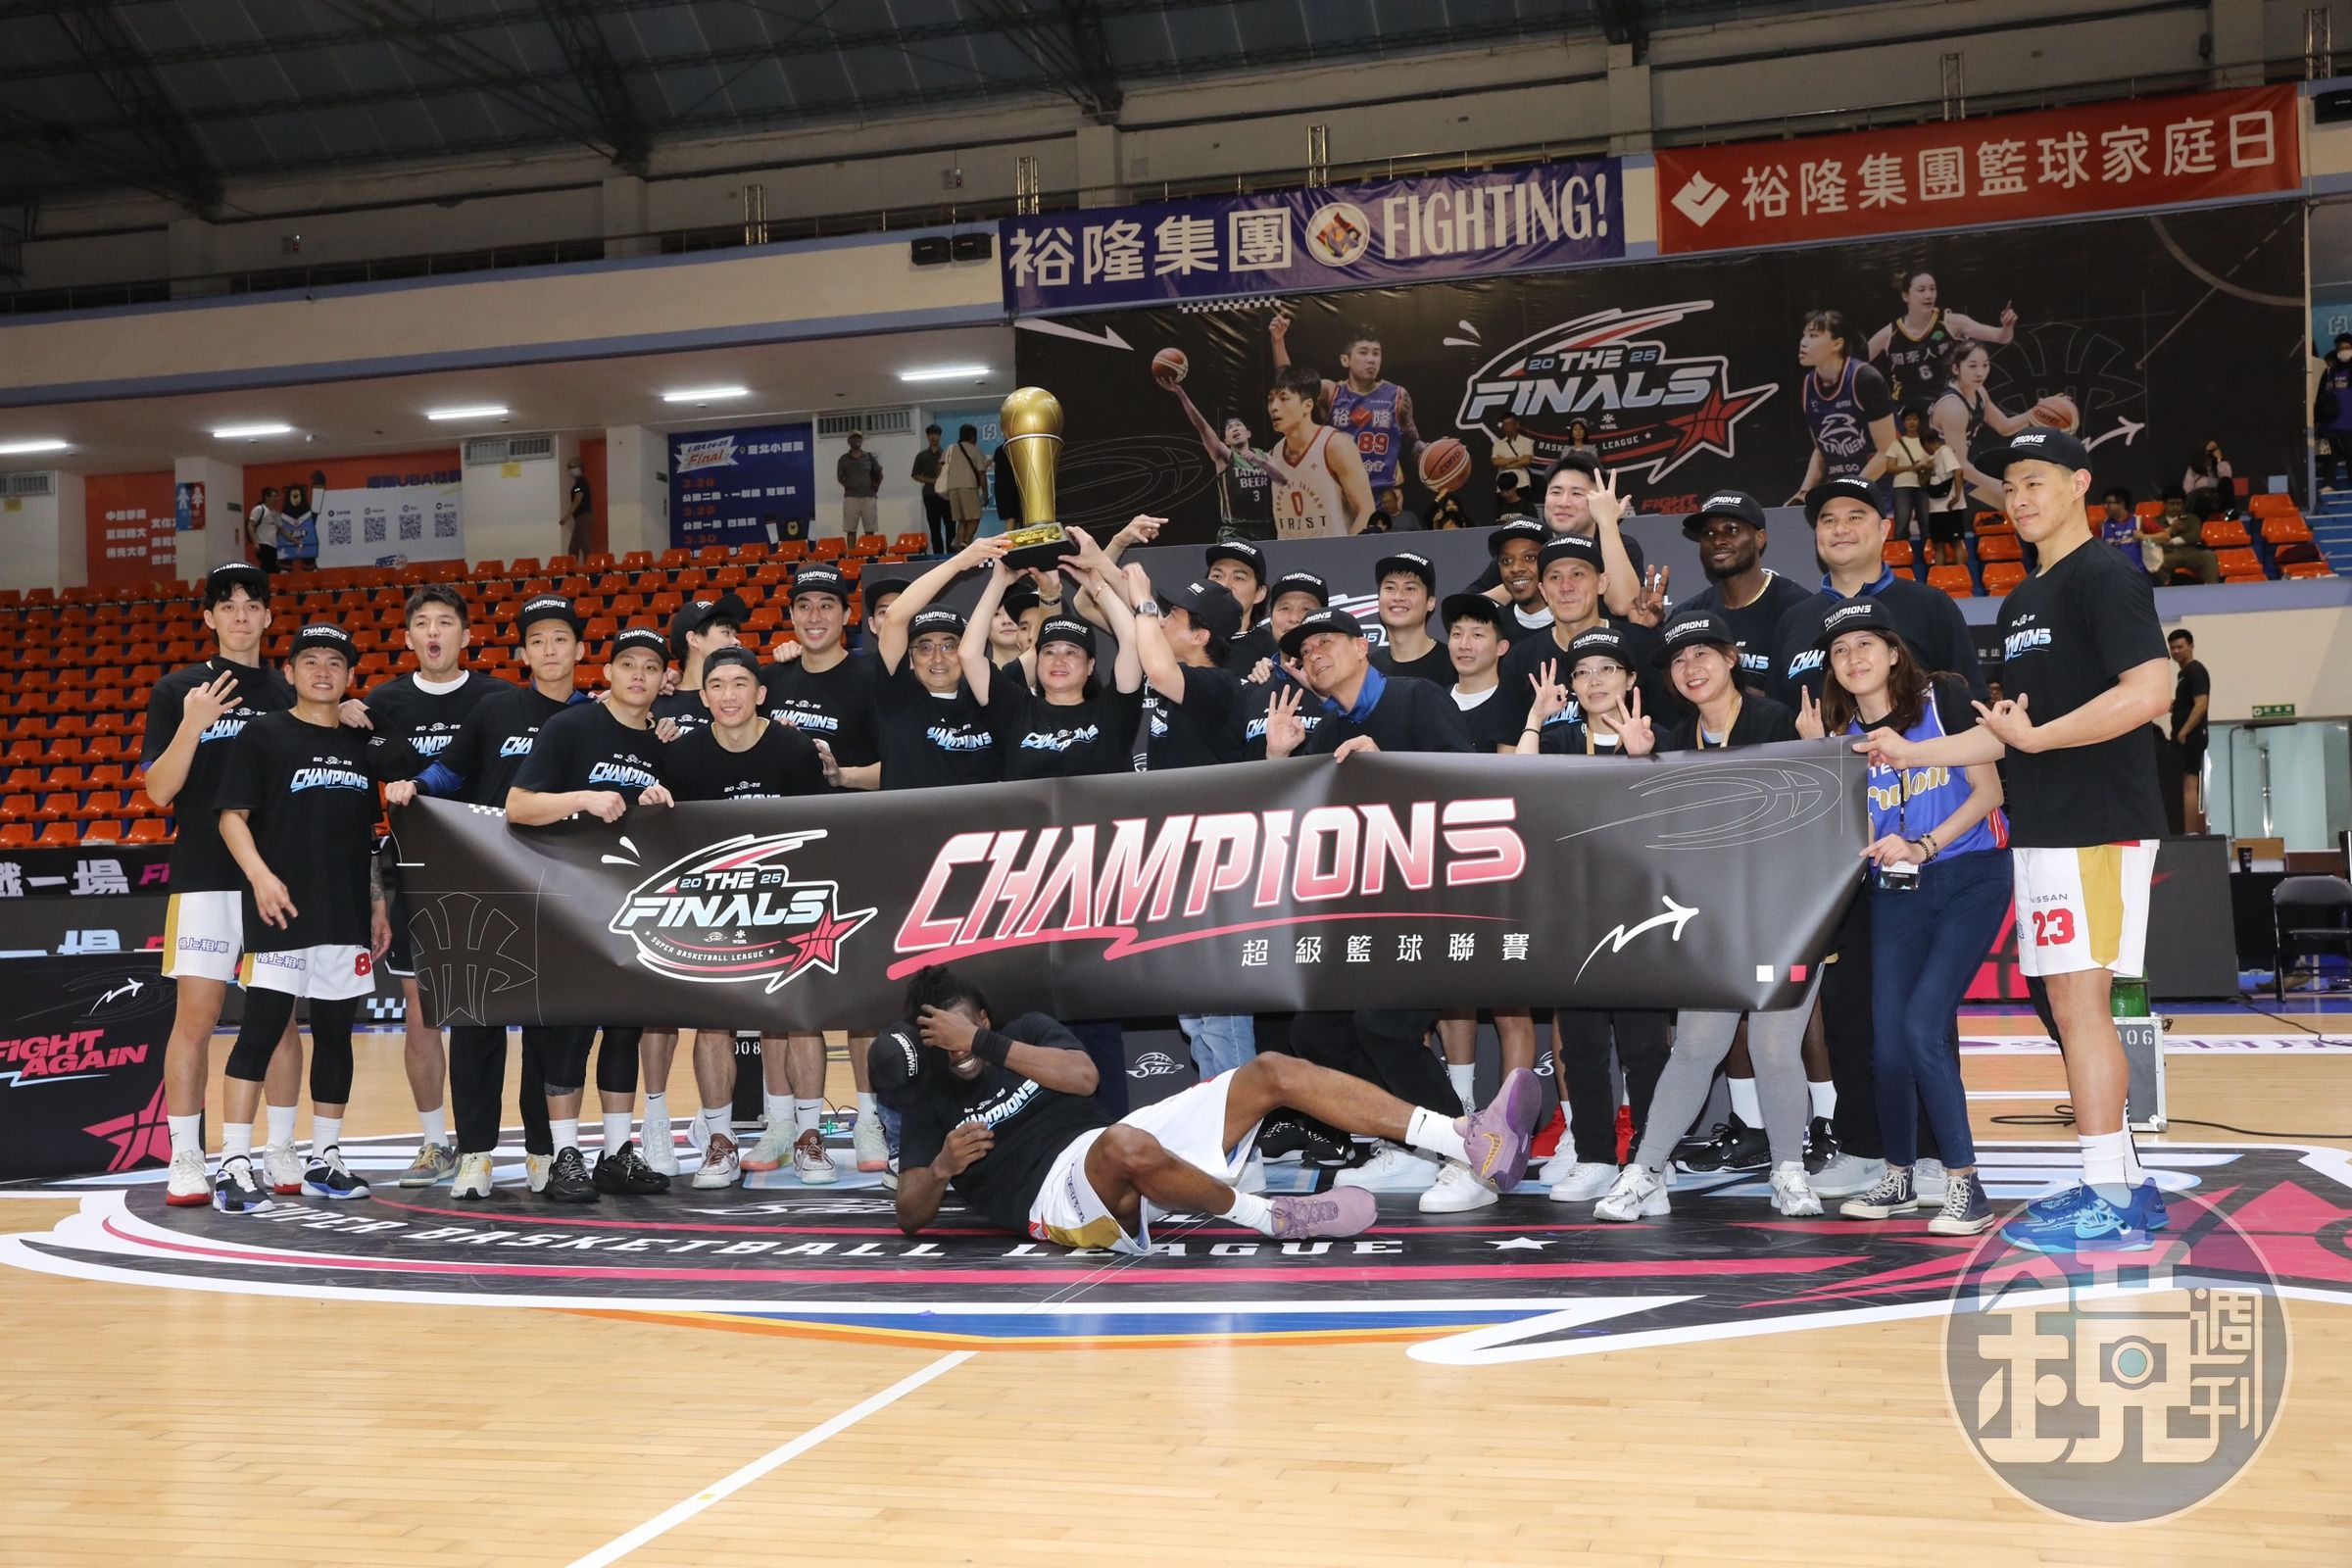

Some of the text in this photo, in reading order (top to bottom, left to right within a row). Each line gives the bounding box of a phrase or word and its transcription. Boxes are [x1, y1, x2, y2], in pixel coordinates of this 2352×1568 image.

[1741, 109, 2275, 221] 裕隆集團籃球家庭日
[1008, 173, 1608, 287] 裕隆集團 FIGHTING!
[1527, 349, 1656, 371] 20 THE 25
[1466, 366, 1717, 419] FINALS
[1358, 431, 1389, 455] 89
[1602, 435, 1640, 450] LEAGUE
[2010, 435, 2046, 447] PIONS
[688, 449, 724, 466] Final
[1234, 466, 1267, 477] TAIWA
[1240, 477, 1268, 488] BEER
[1253, 490, 1260, 502] 3
[1220, 542, 1257, 555] MPIONS
[1396, 553, 1429, 566] MPIONS
[798, 571, 838, 581] CHAMPIONS
[525, 600, 566, 612] CHAMPIONS
[1824, 604, 1872, 625] CHAMPIONS
[914, 612, 957, 623] CHAMPIONS
[1302, 612, 1332, 623] PIONS
[303, 627, 347, 640] CHAMPIONS
[619, 629, 664, 643] CHAMPIONS
[1045, 620, 1089, 634] CHAMPIONS
[1665, 619, 1710, 638] CHAMPIONS
[1573, 634, 1619, 647] CHAMPIONS
[1247, 716, 1322, 740] CHANS
[589, 762, 660, 788] CHAMPION
[1869, 763, 1895, 777] TE
[290, 769, 368, 790] CHAMPIONS
[680, 871, 782, 891] 20 THE 25
[893, 797, 1527, 954] CHAMPIONS
[619, 889, 830, 927] FINALS
[2033, 907, 2076, 947] 23
[178, 937, 229, 954] 格上租車
[651, 936, 764, 961] SUPER BASKETBALL LEAGUE
[1241, 932, 1530, 967] 超級籃球聯賽
[256, 953, 306, 970] 格上租車
[0, 1030, 104, 1062] FIGHT
[2119, 1029, 2153, 1046] 06
[22, 1045, 149, 1078] AGAIN
[956, 1078, 1040, 1129] AMPIONS
[400, 1226, 947, 1256] BASKETBALL
